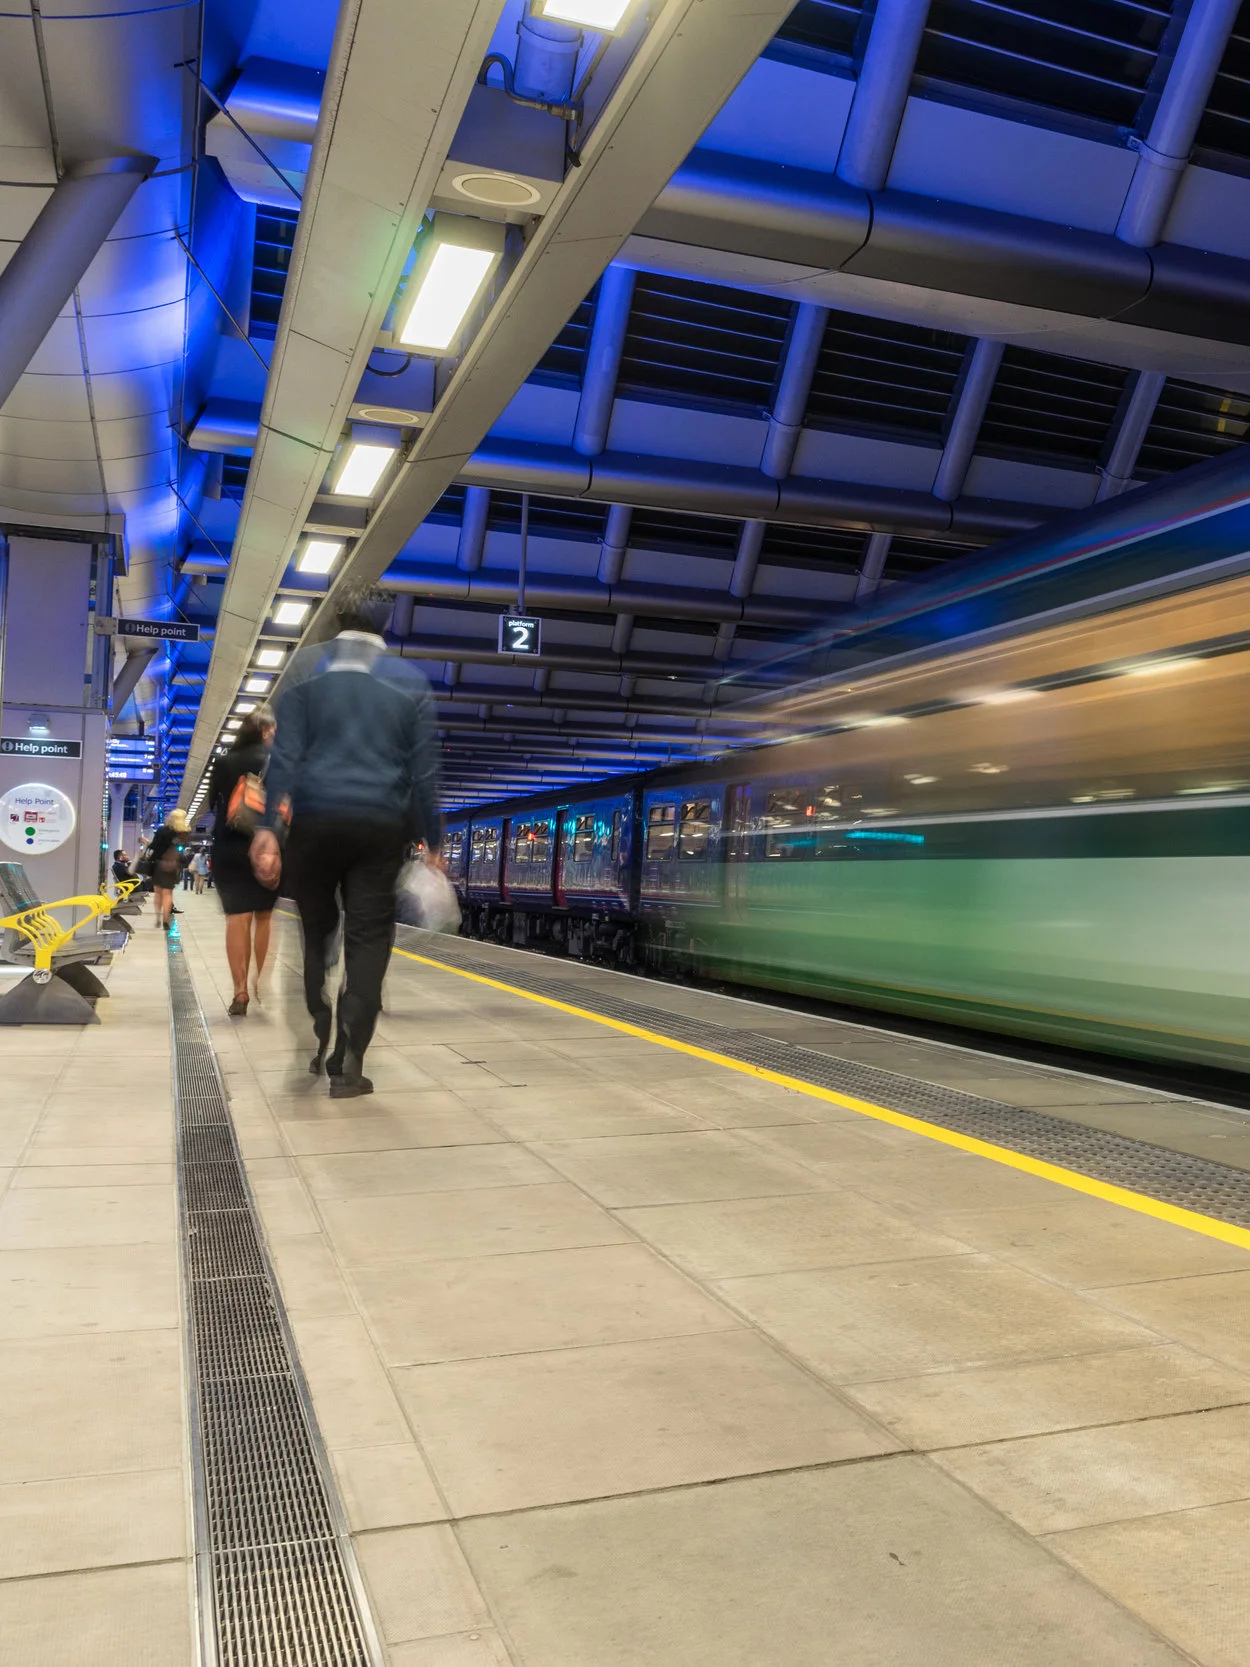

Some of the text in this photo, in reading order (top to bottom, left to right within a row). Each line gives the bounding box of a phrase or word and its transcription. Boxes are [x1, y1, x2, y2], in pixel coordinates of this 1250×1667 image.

[508, 620, 534, 628] platform
[136, 624, 186, 637] Help point
[512, 626, 529, 650] 2
[15, 742, 68, 754] Help point
[15, 797, 54, 806] Help Point
